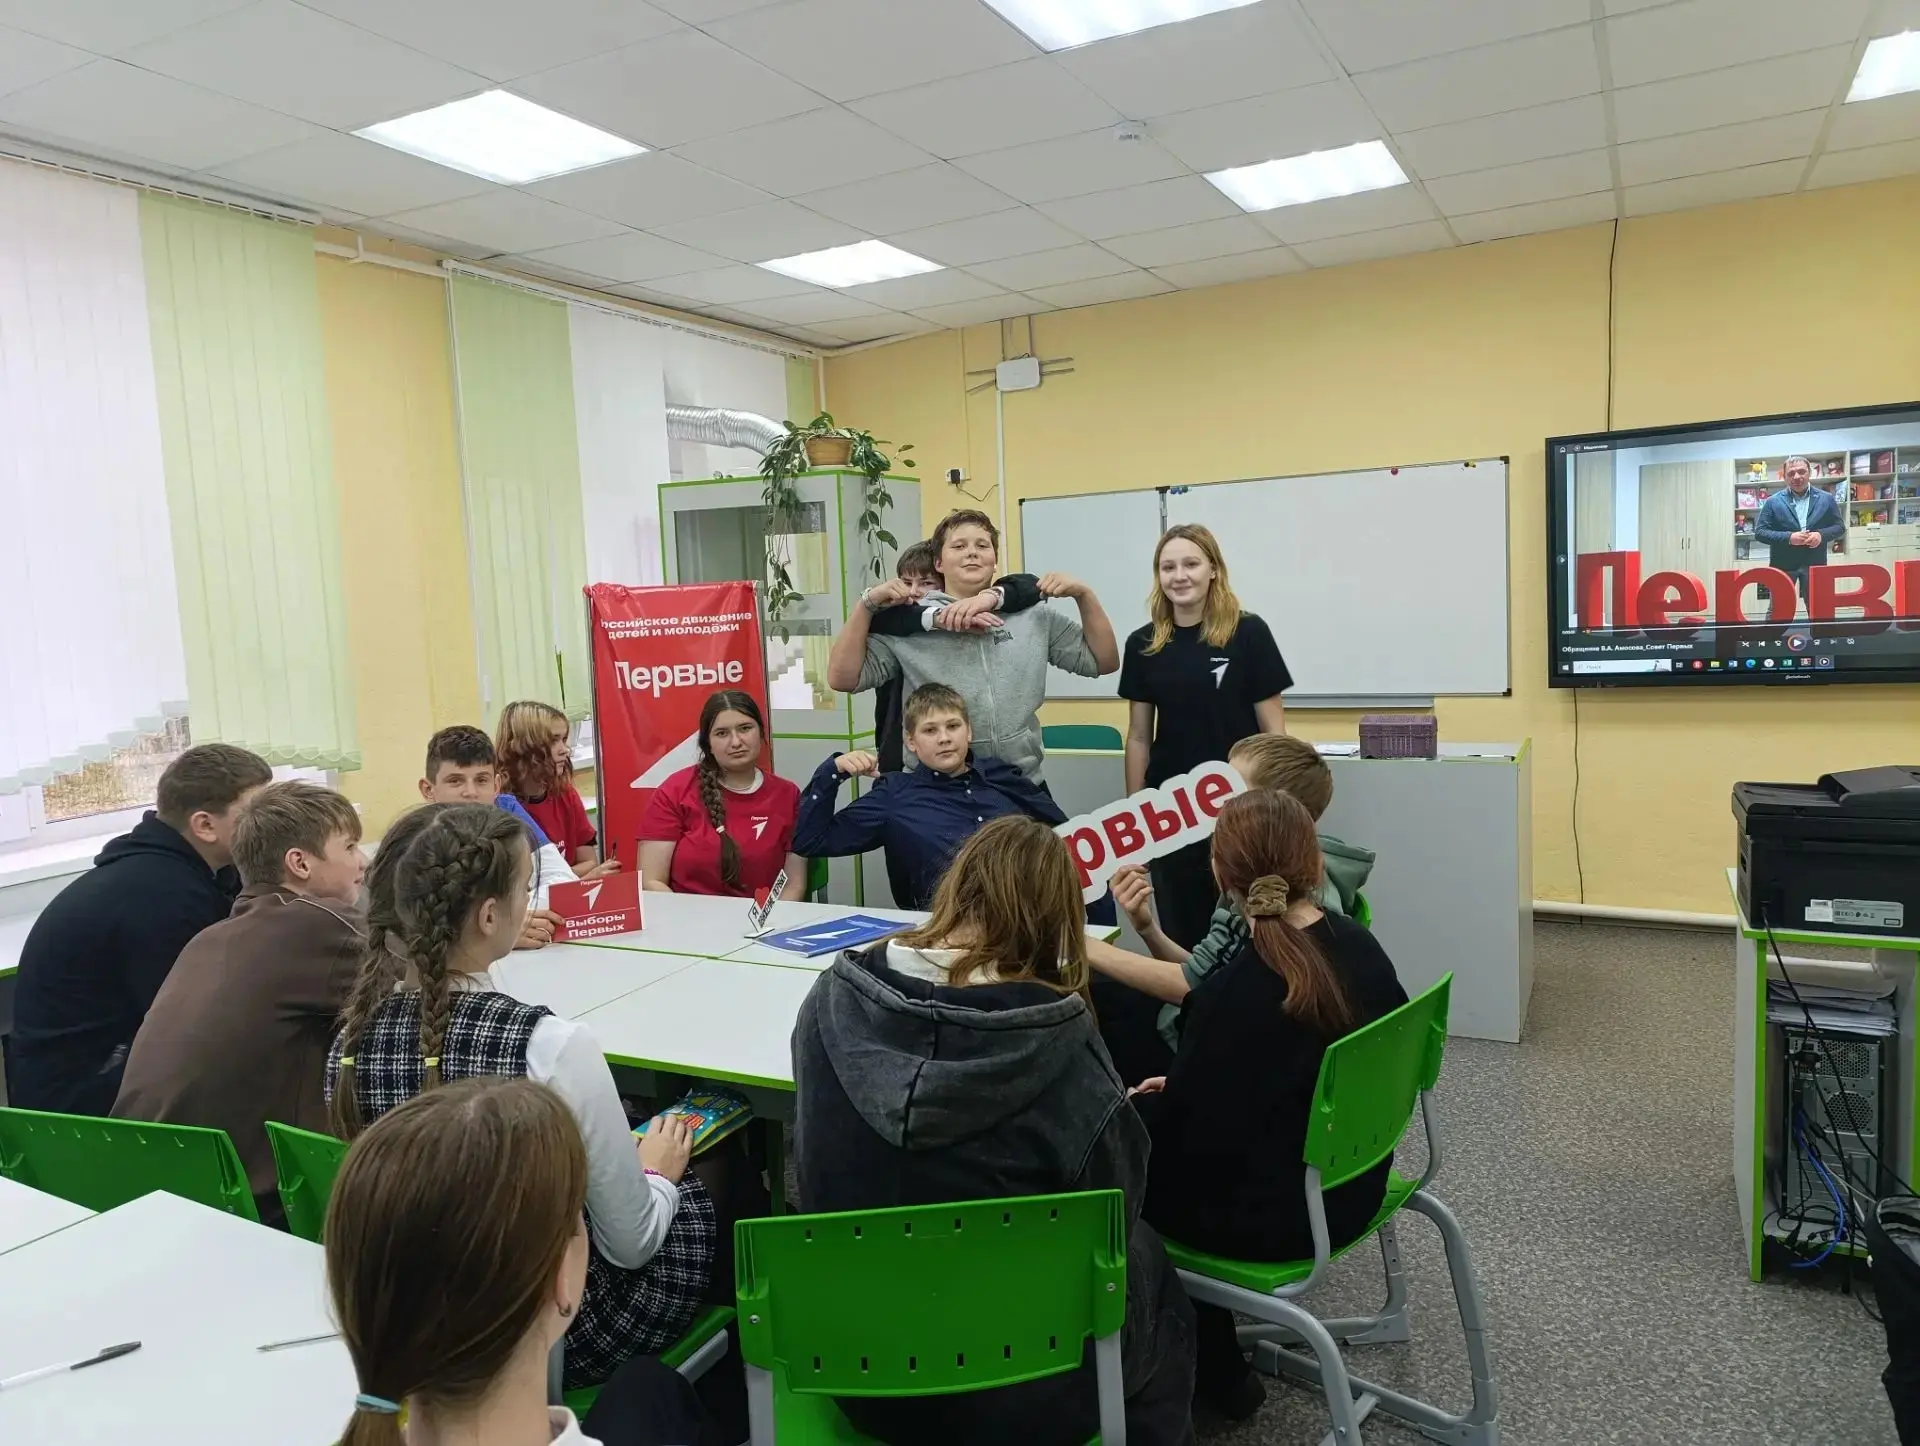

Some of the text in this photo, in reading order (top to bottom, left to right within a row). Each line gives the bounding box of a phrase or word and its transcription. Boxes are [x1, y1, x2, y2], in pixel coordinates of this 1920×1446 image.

[601, 612, 752, 630] оссийское движение
[608, 623, 740, 640] детей и молодёжи
[614, 660, 743, 698] Первые
[1062, 773, 1234, 889] рвые
[565, 914, 626, 928] Выборы
[568, 924, 625, 938] Первых
